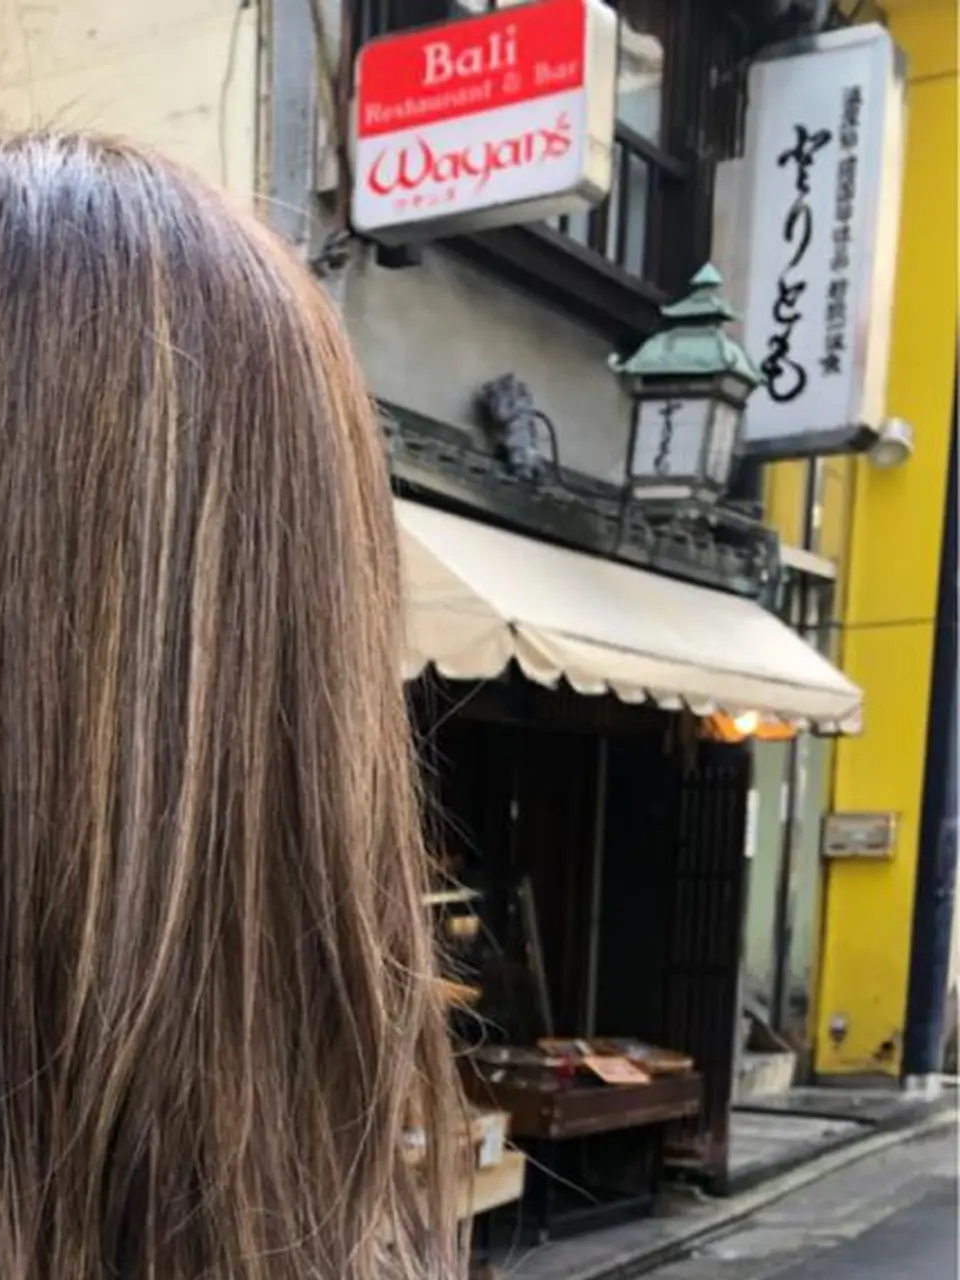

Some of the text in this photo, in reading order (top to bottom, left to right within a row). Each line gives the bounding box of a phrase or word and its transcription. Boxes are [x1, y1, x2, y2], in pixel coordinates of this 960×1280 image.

[422, 24, 518, 86] Bali
[364, 81, 493, 125] Restaurant
[534, 60, 579, 85] Bar
